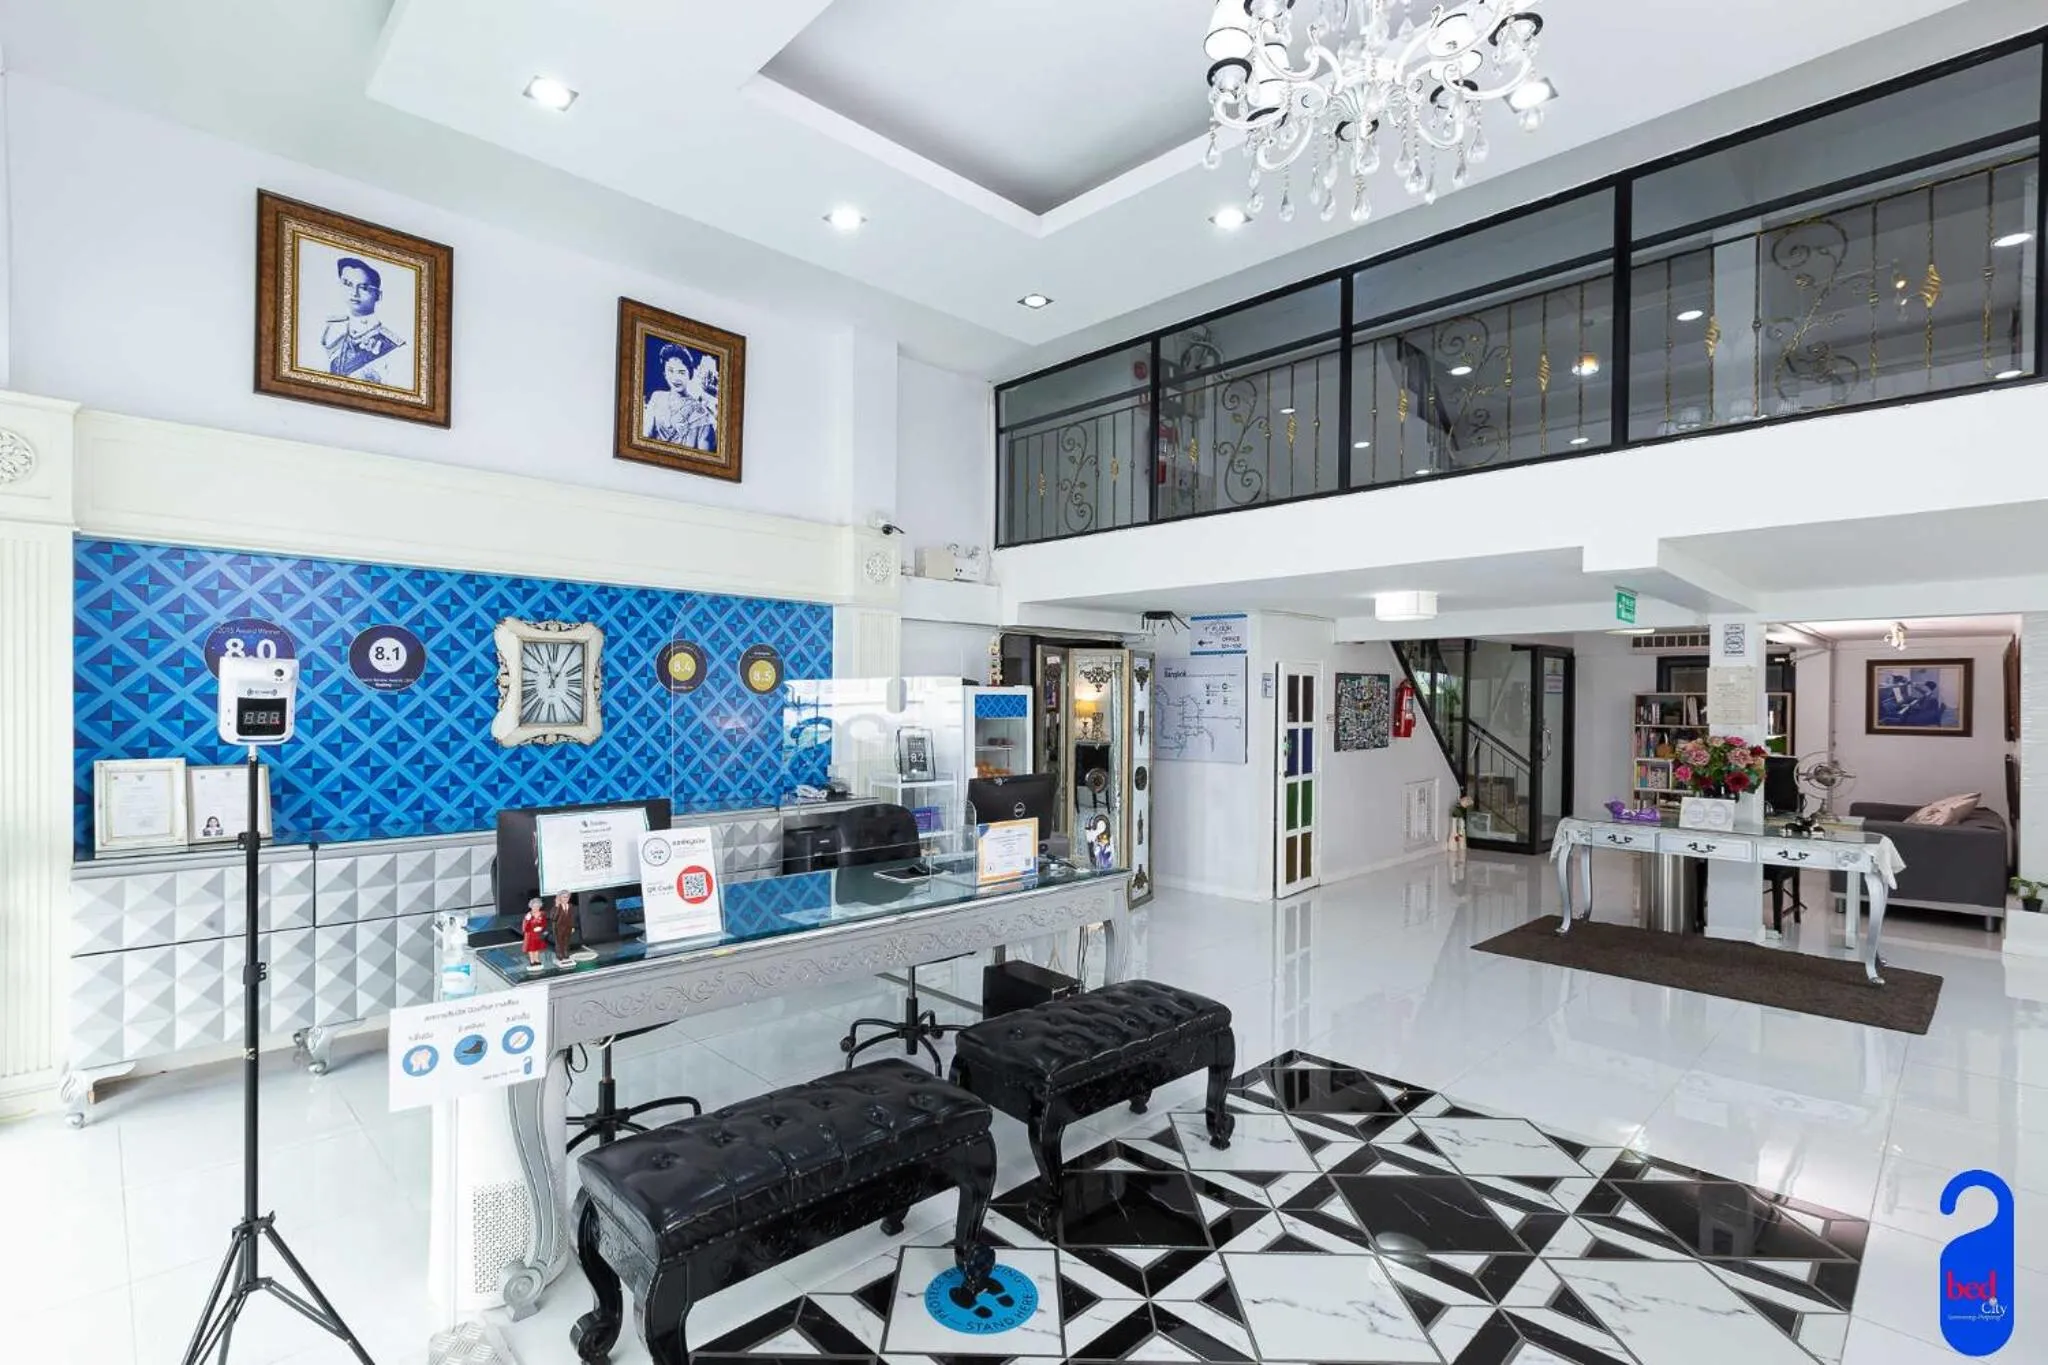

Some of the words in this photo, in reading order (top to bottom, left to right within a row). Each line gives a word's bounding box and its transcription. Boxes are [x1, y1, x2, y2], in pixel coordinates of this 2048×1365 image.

[223, 637, 277, 660] 80
[374, 646, 401, 661] 8.1
[966, 1315, 1015, 1332] STAND
[1015, 1293, 1033, 1319] HERE
